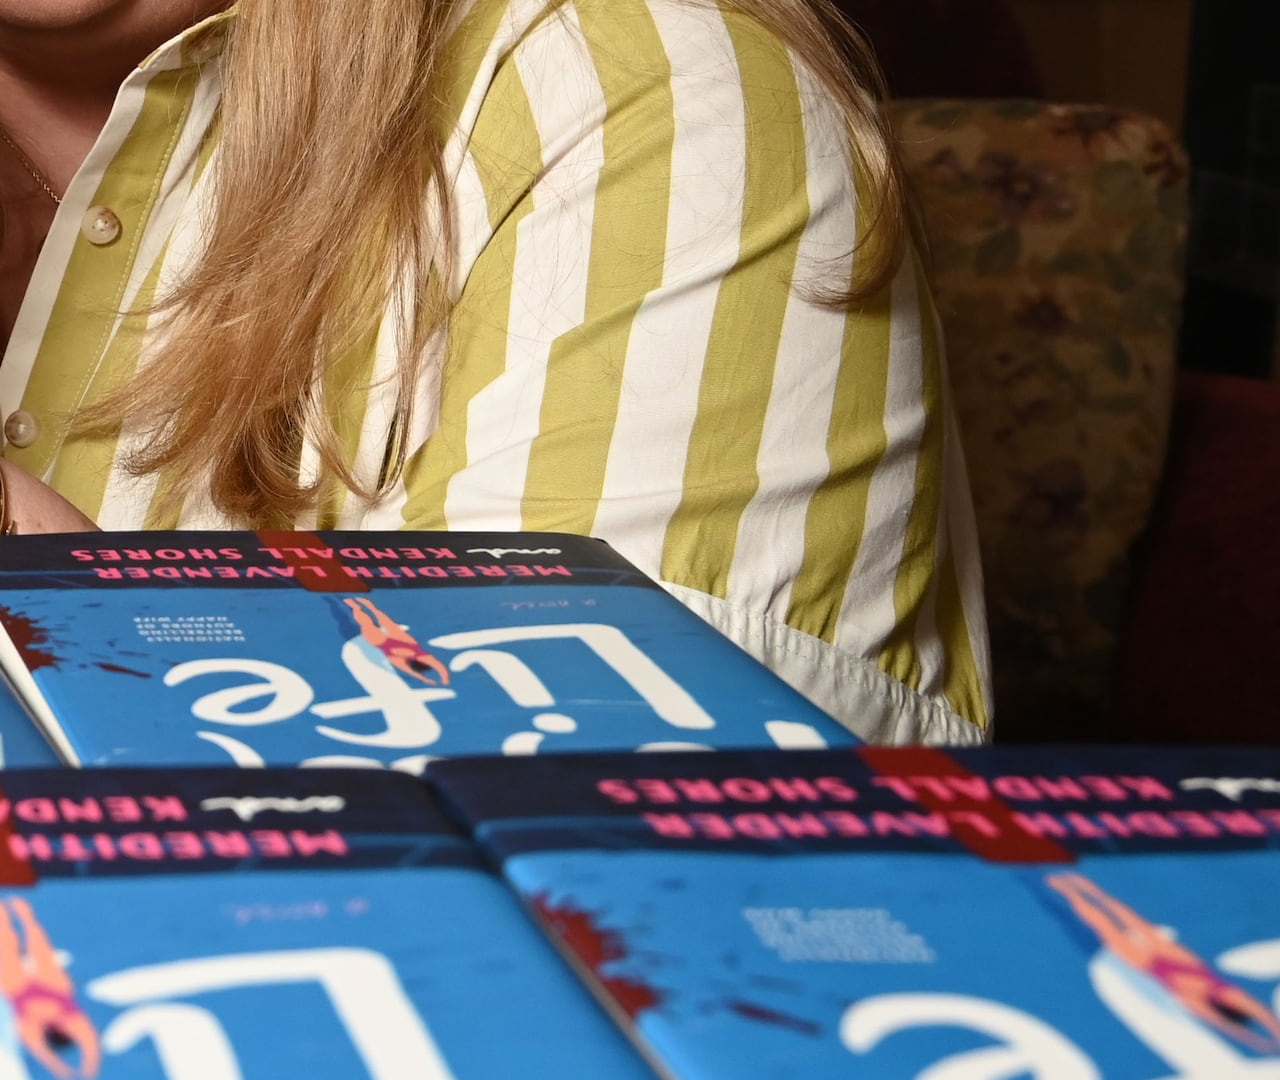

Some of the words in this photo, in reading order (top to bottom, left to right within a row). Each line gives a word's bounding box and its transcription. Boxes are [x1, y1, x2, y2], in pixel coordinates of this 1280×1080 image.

[70, 547, 243, 562] SHORES
[258, 546, 458, 561] KENDALL
[466, 545, 563, 561] and
[93, 565, 331, 581] LAVENDER
[343, 563, 573, 579] MEREDITH
[163, 623, 716, 748] Life
[596, 776, 859, 804] SHORES
[870, 775, 1174, 801] KENDALL
[642, 809, 1000, 839] LAVENDER
[7, 829, 349, 862] MEREDITH
